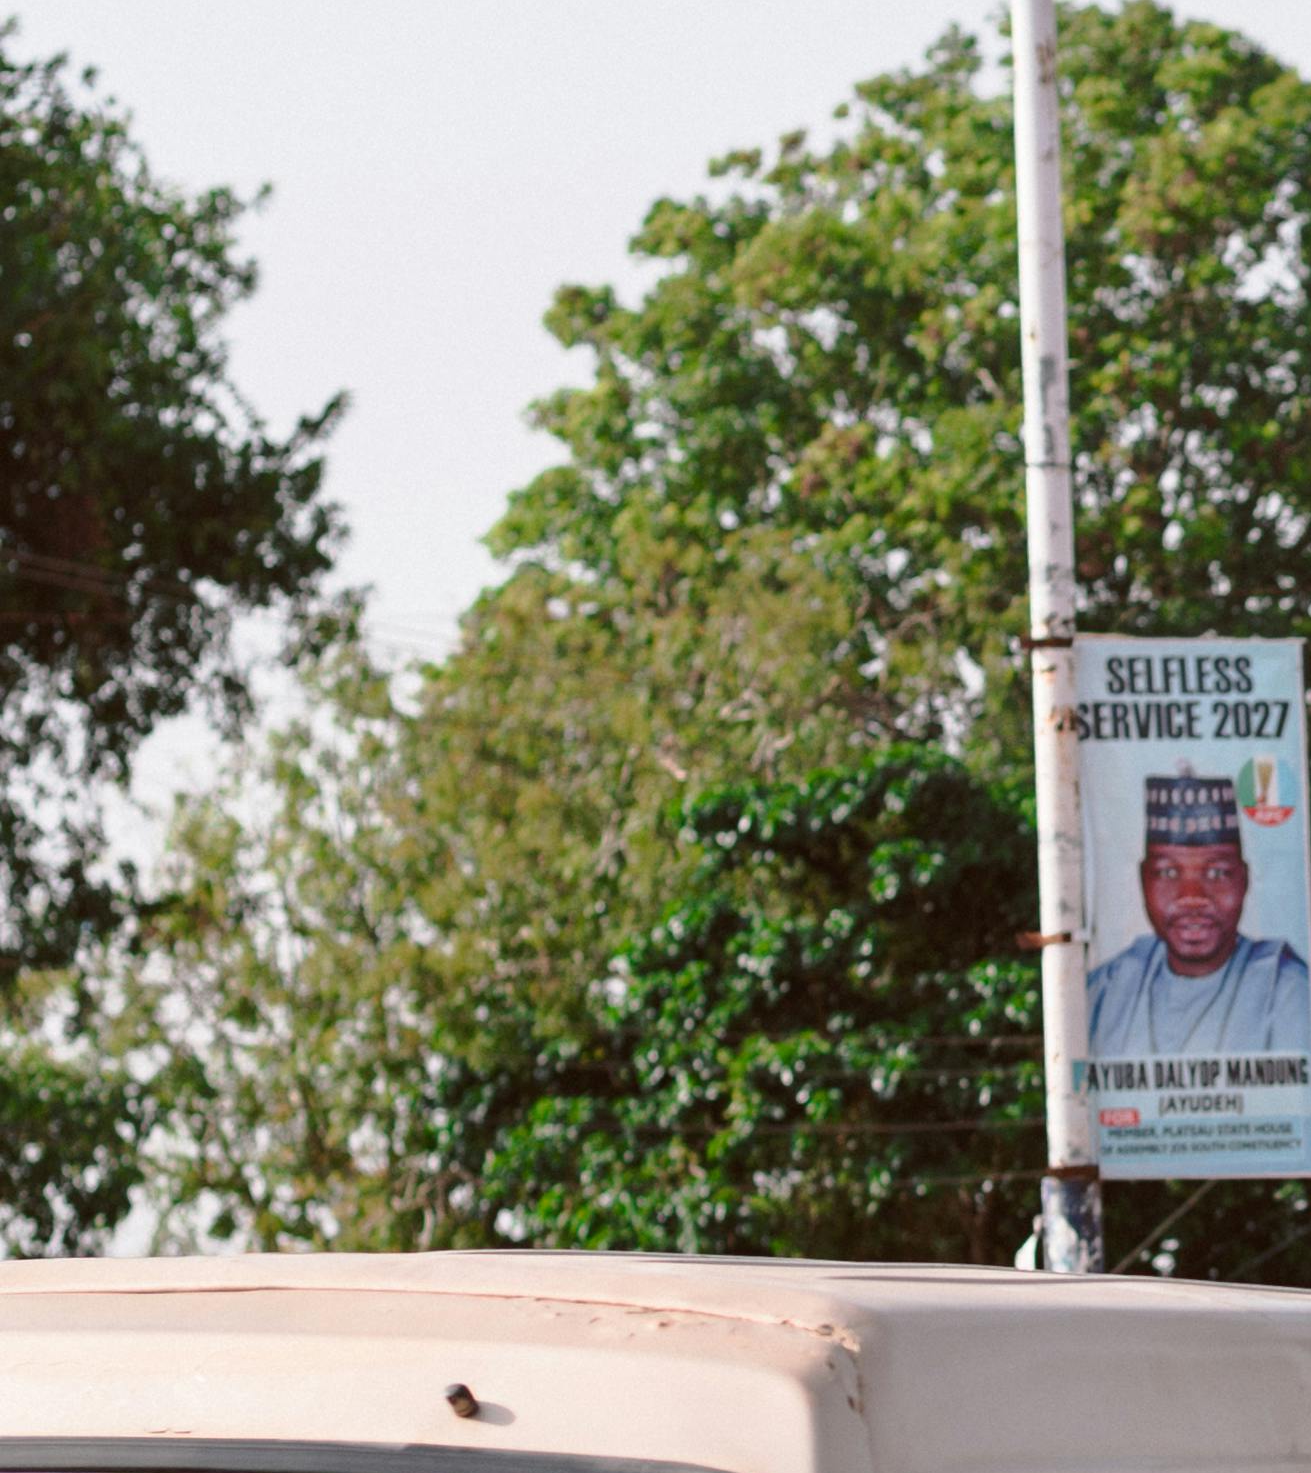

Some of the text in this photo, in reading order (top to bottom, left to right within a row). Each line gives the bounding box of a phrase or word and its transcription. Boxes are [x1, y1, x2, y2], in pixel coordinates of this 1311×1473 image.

[1106, 656, 1253, 695] SELFLESS
[1077, 701, 1290, 741] SERVICE 2027
[1086, 1057, 1309, 1090] AYUBA DALYOP MANDUNG
[1158, 1094, 1244, 1115] (AYUDEH)
